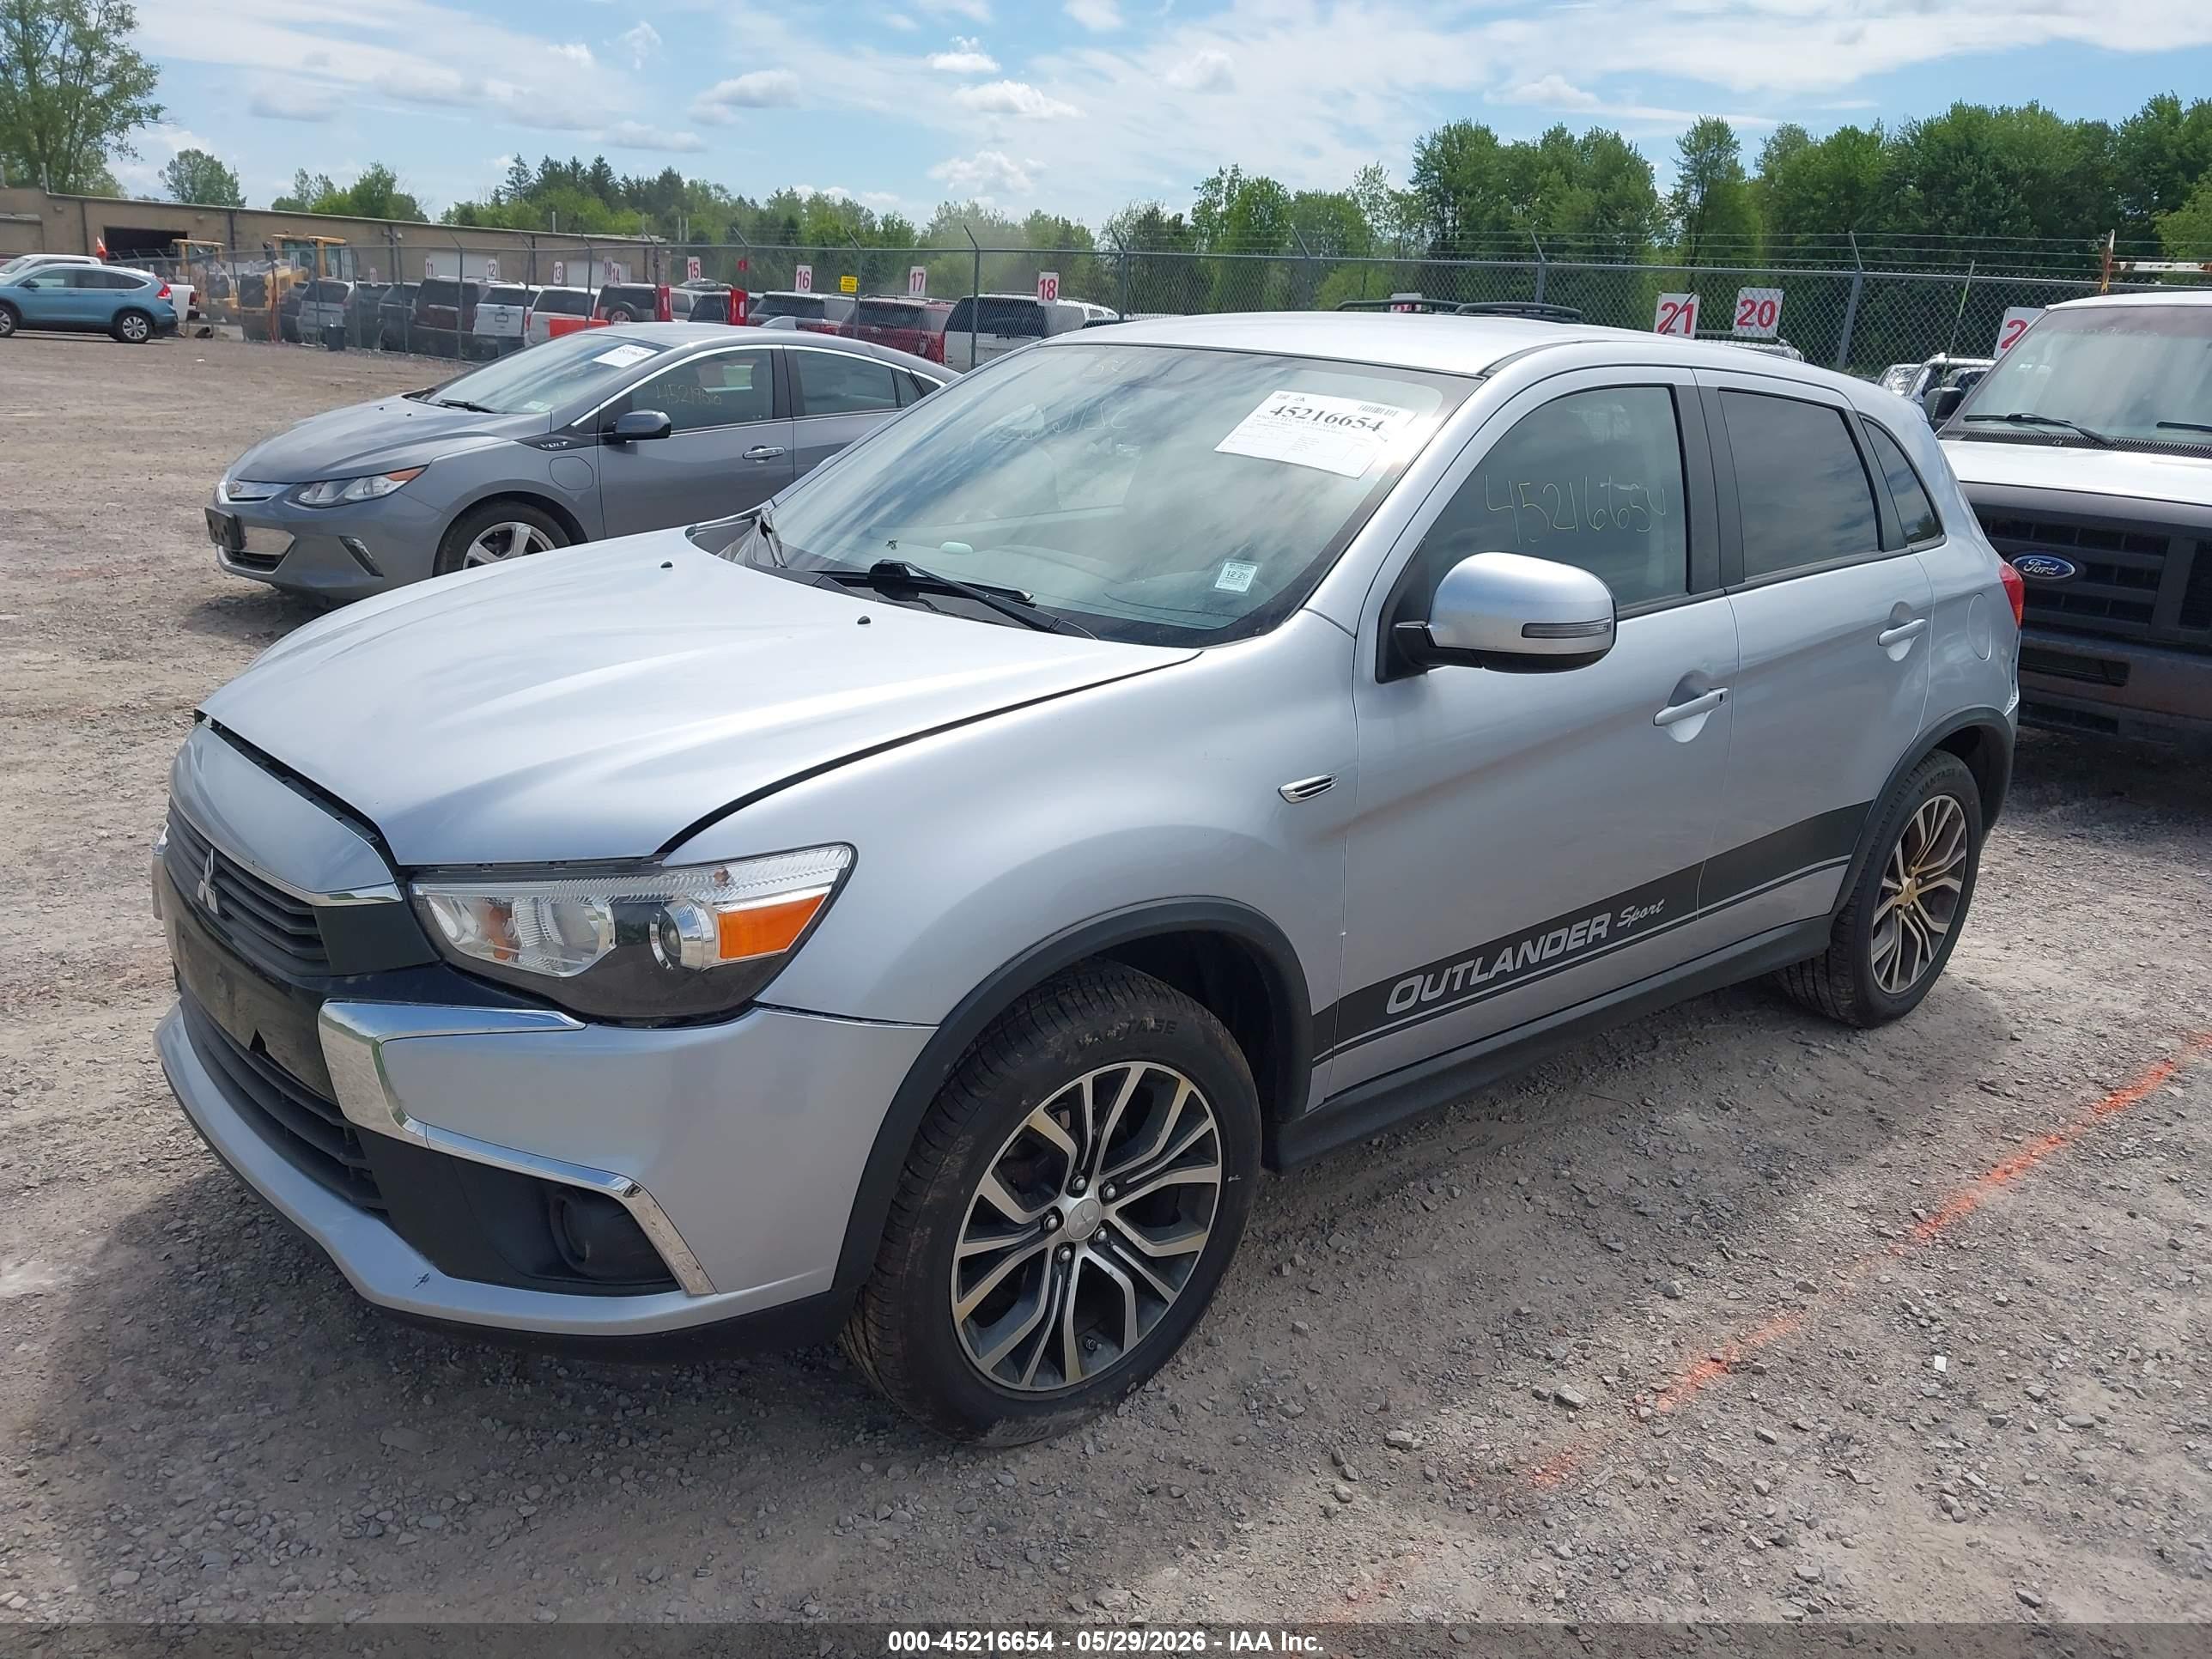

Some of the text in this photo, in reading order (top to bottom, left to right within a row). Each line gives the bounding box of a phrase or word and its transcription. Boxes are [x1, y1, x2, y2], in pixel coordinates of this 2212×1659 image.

[487, 263, 495, 276] 12
[554, 266, 562, 282] 13
[689, 262, 699, 278] 15
[798, 270, 811, 289] 16
[911, 272, 925, 292] 17
[1040, 278, 1057, 301] 18
[1657, 301, 1694, 334] 21
[1737, 299, 1776, 328] 20
[2001, 319, 2029, 349] 2
[1269, 404, 1386, 432] 45216654
[1484, 474, 1667, 544] 45216654
[2023, 558, 2060, 576] Ford
[1386, 898, 1665, 1015] OUTLANDER Sport
